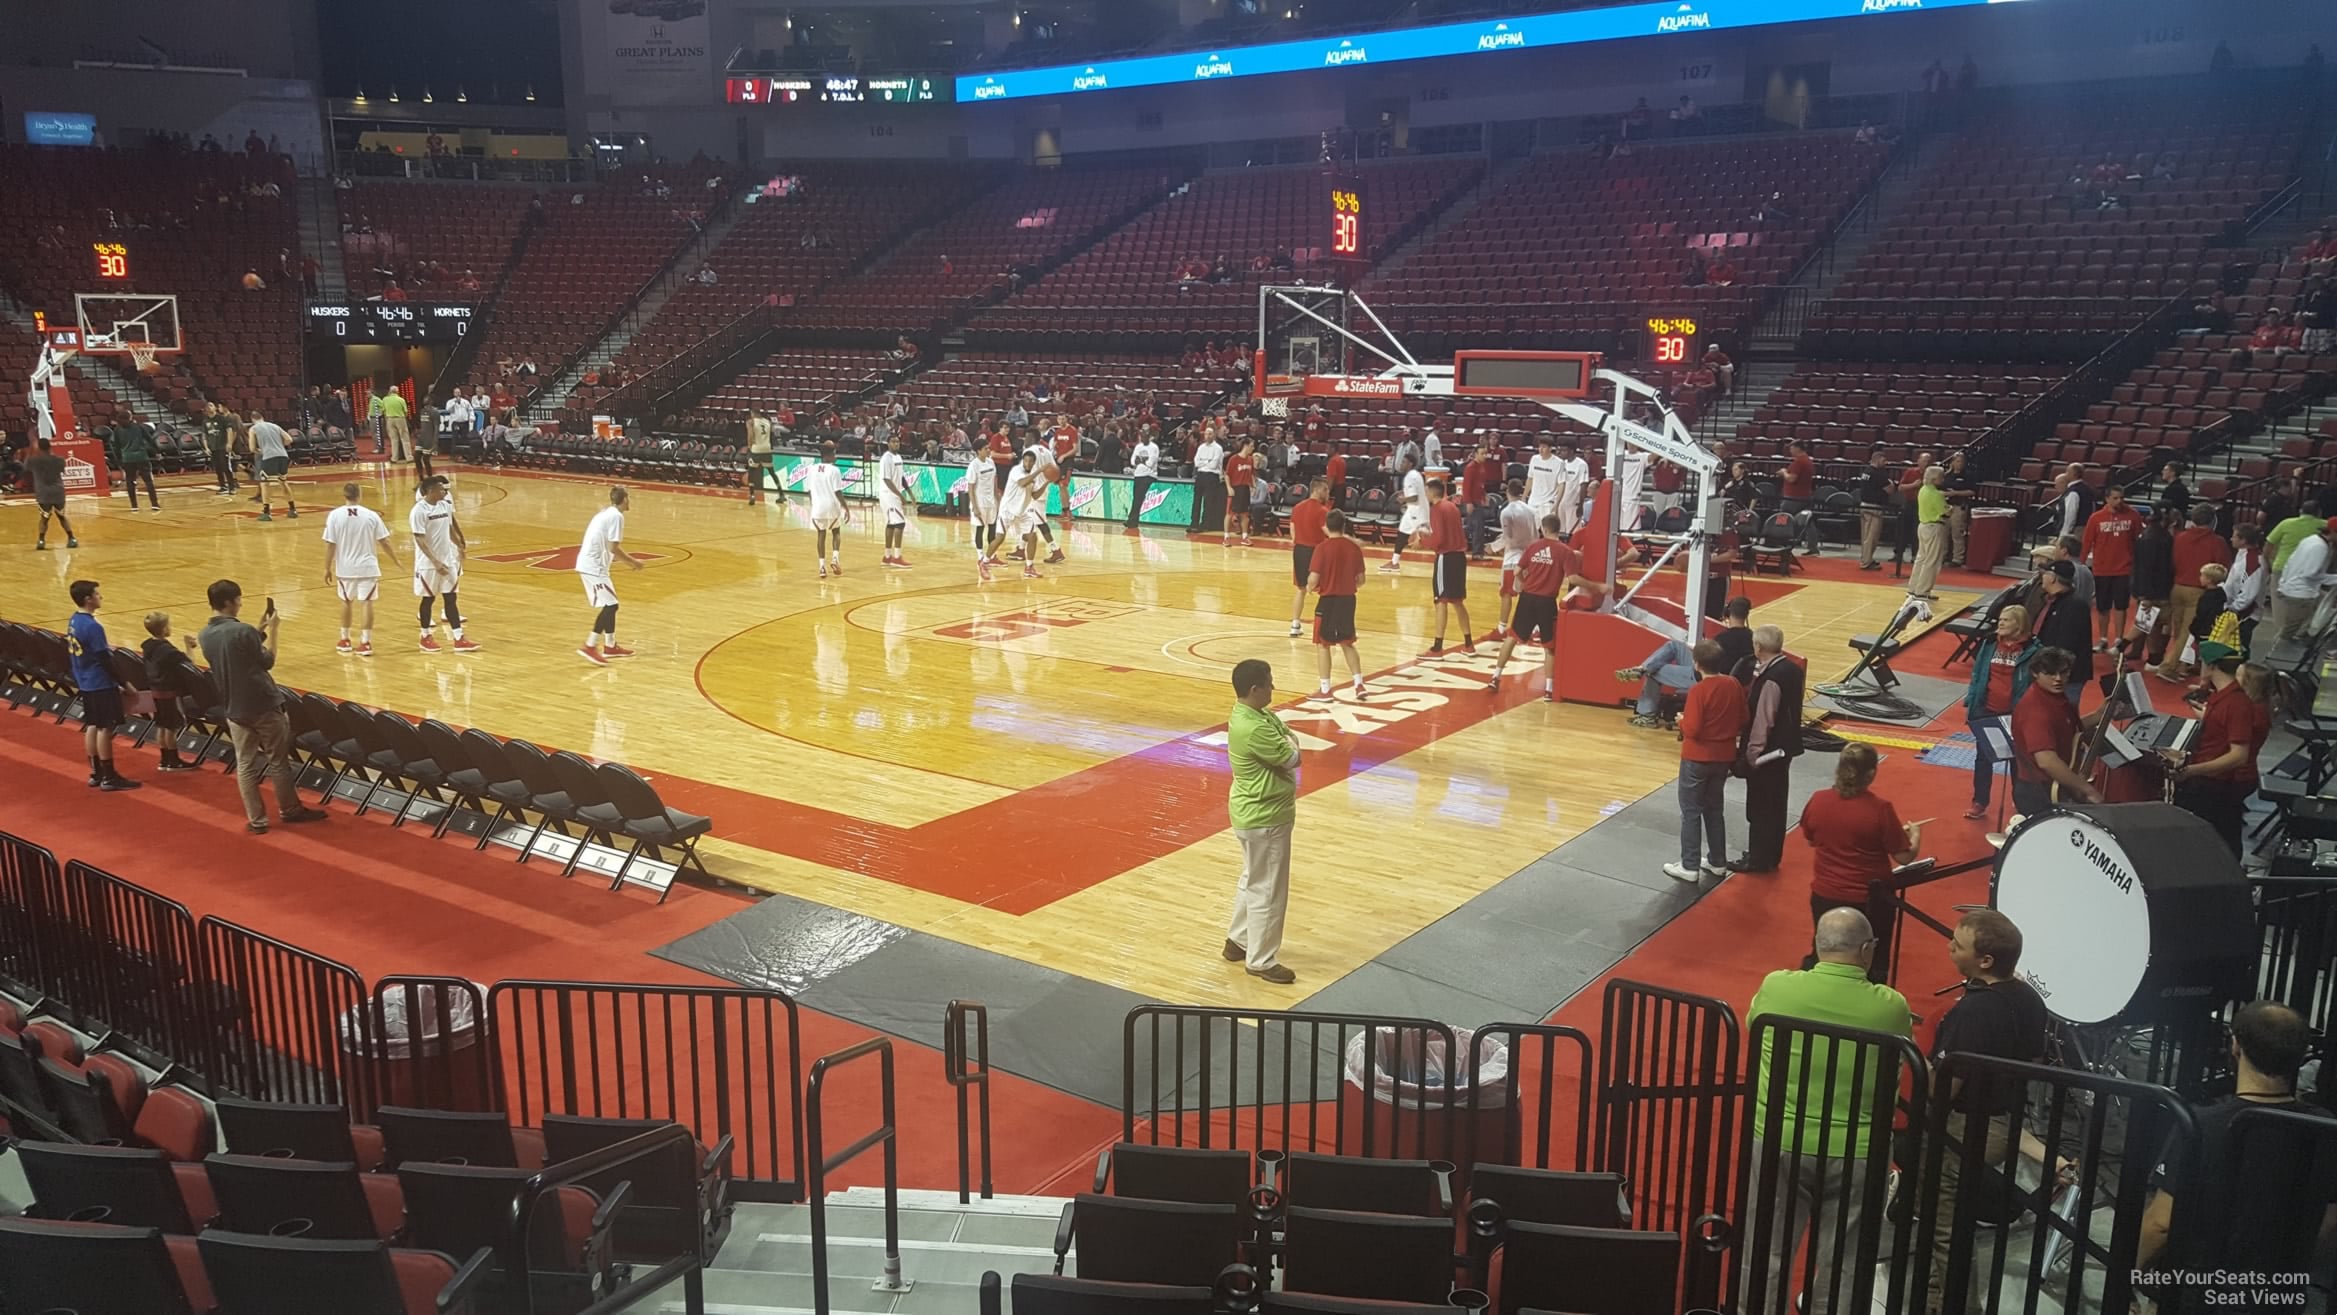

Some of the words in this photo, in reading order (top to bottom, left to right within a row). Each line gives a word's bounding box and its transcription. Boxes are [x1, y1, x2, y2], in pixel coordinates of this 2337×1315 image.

[1657, 12, 1711, 32] AQUAFINA
[1478, 31, 1525, 49] AQUAFINA
[615, 47, 656, 57] GREAT
[659, 47, 704, 57] PLAINS
[1325, 48, 1367, 65] AQUAFINA
[1195, 61, 1232, 78] AQUAFINA
[1680, 64, 1712, 80] 107
[745, 81, 752, 91] 0
[773, 81, 812, 90] HUSKERS
[869, 81, 908, 89] HORNETS
[922, 81, 930, 90] 0
[1073, 74, 1107, 90] AQUAFINA
[1333, 190, 1359, 213] 46:46
[1336, 213, 1356, 252] 30
[94, 243, 126, 255] 46:46
[100, 255, 125, 276] 30
[311, 307, 350, 317] HUSKERS
[376, 306, 413, 320] 46:46
[434, 307, 471, 317] HORNETS
[336, 321, 346, 336] 0
[457, 321, 467, 336] 0
[1649, 319, 1696, 335] 46:46
[1658, 338, 1684, 360] 30
[1668, 447, 1698, 465] Sports
[348, 508, 358, 517] N
[2084, 839, 2133, 895] YAMAHA
